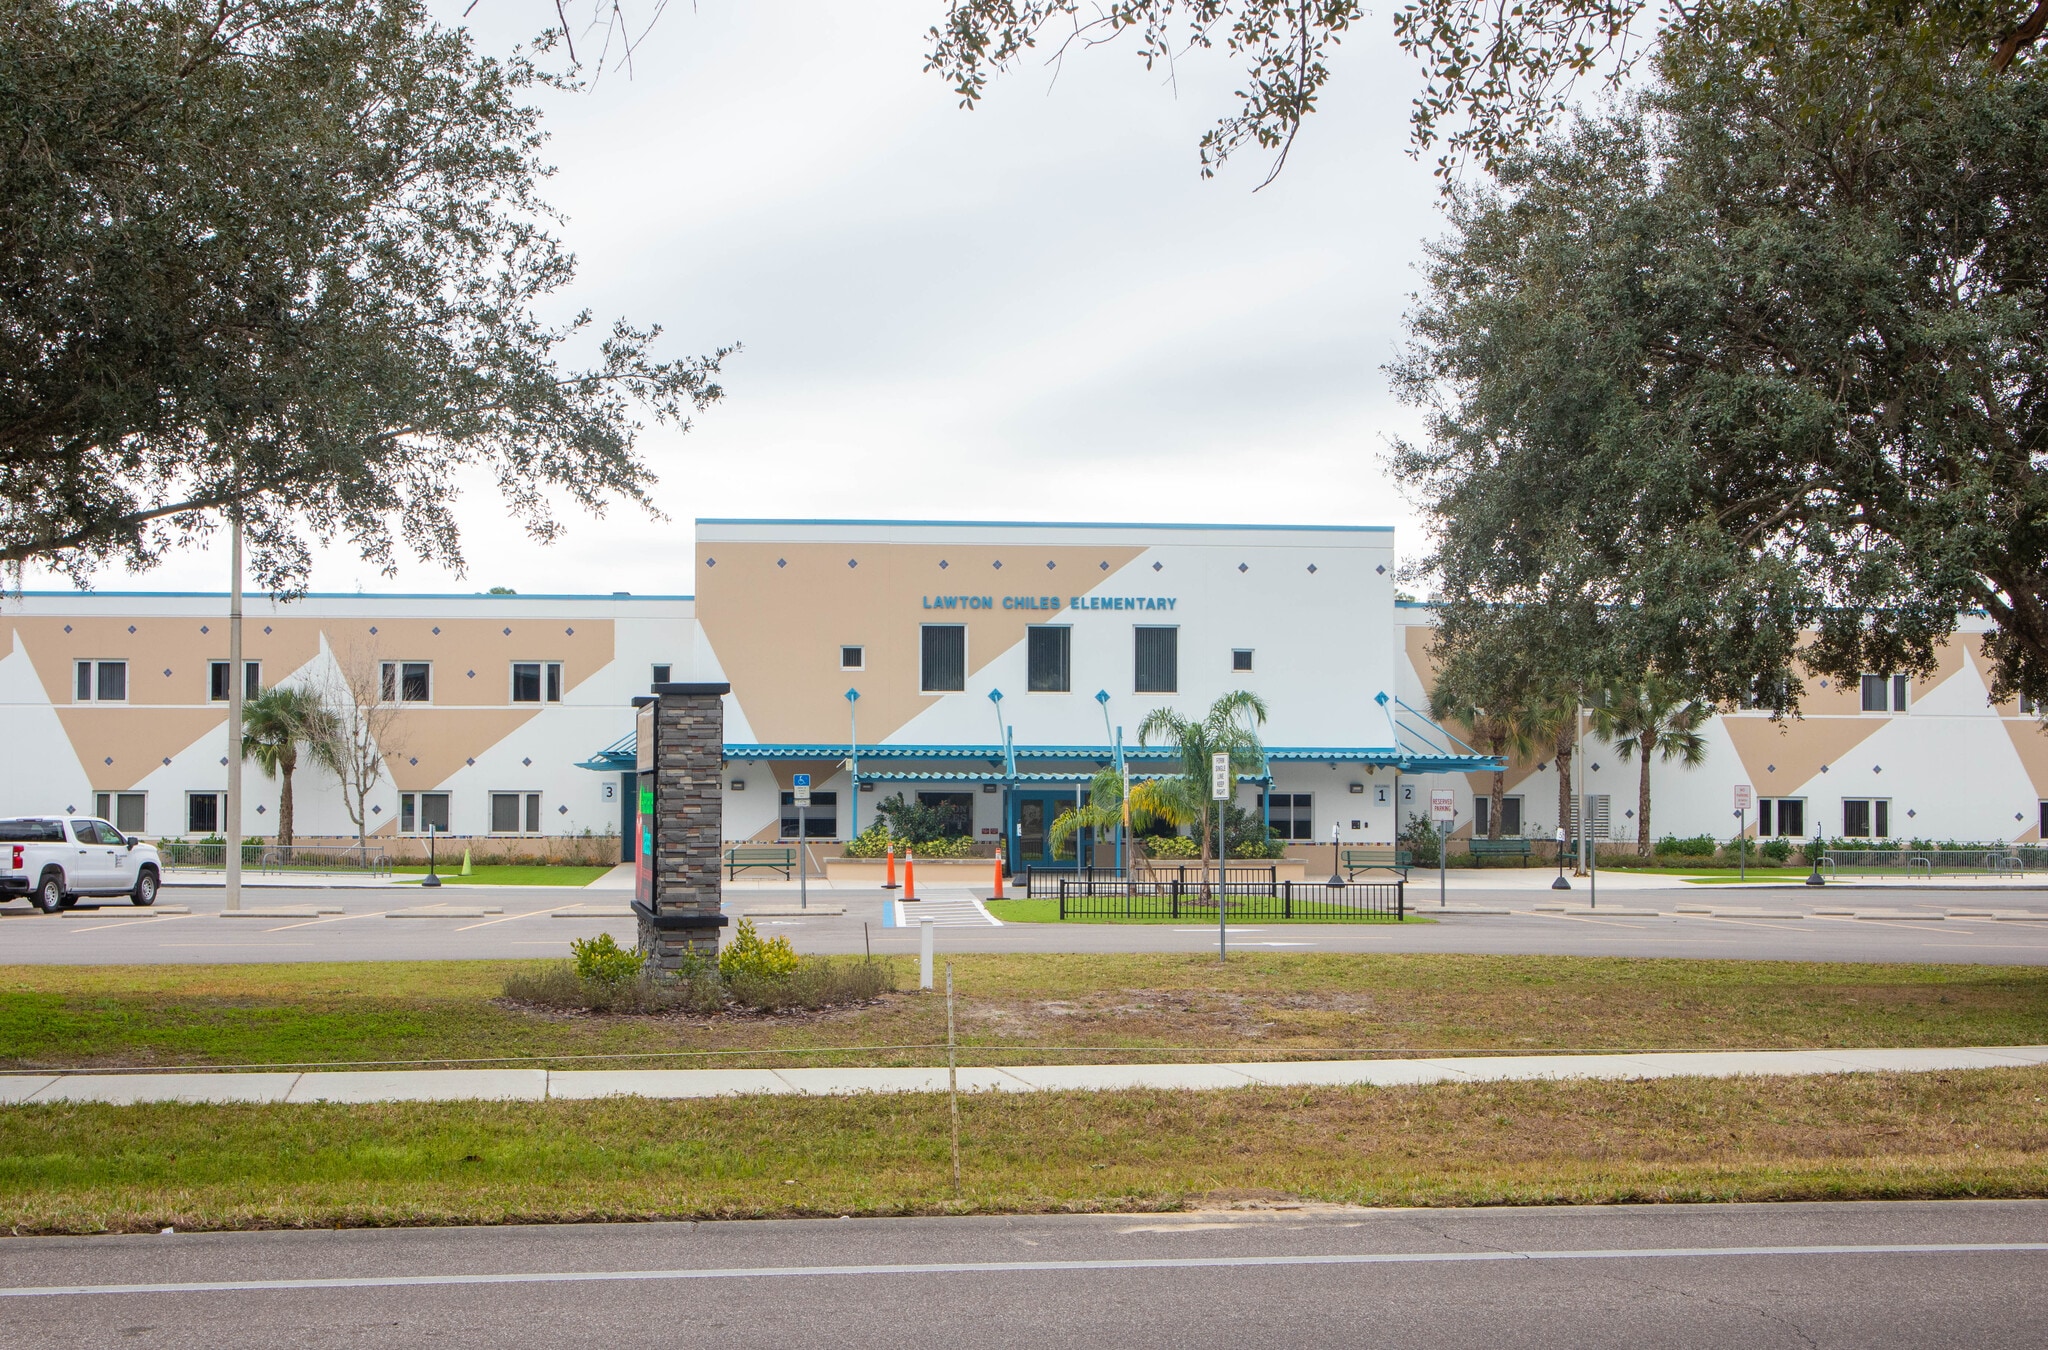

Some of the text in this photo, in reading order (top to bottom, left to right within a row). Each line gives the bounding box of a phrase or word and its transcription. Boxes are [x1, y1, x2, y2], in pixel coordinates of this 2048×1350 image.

[923, 596, 1177, 610] LAWTON CHILES ELEMENTARY
[606, 786, 613, 798] 3
[1378, 789, 1386, 802] 1
[1405, 788, 1412, 800] 2
